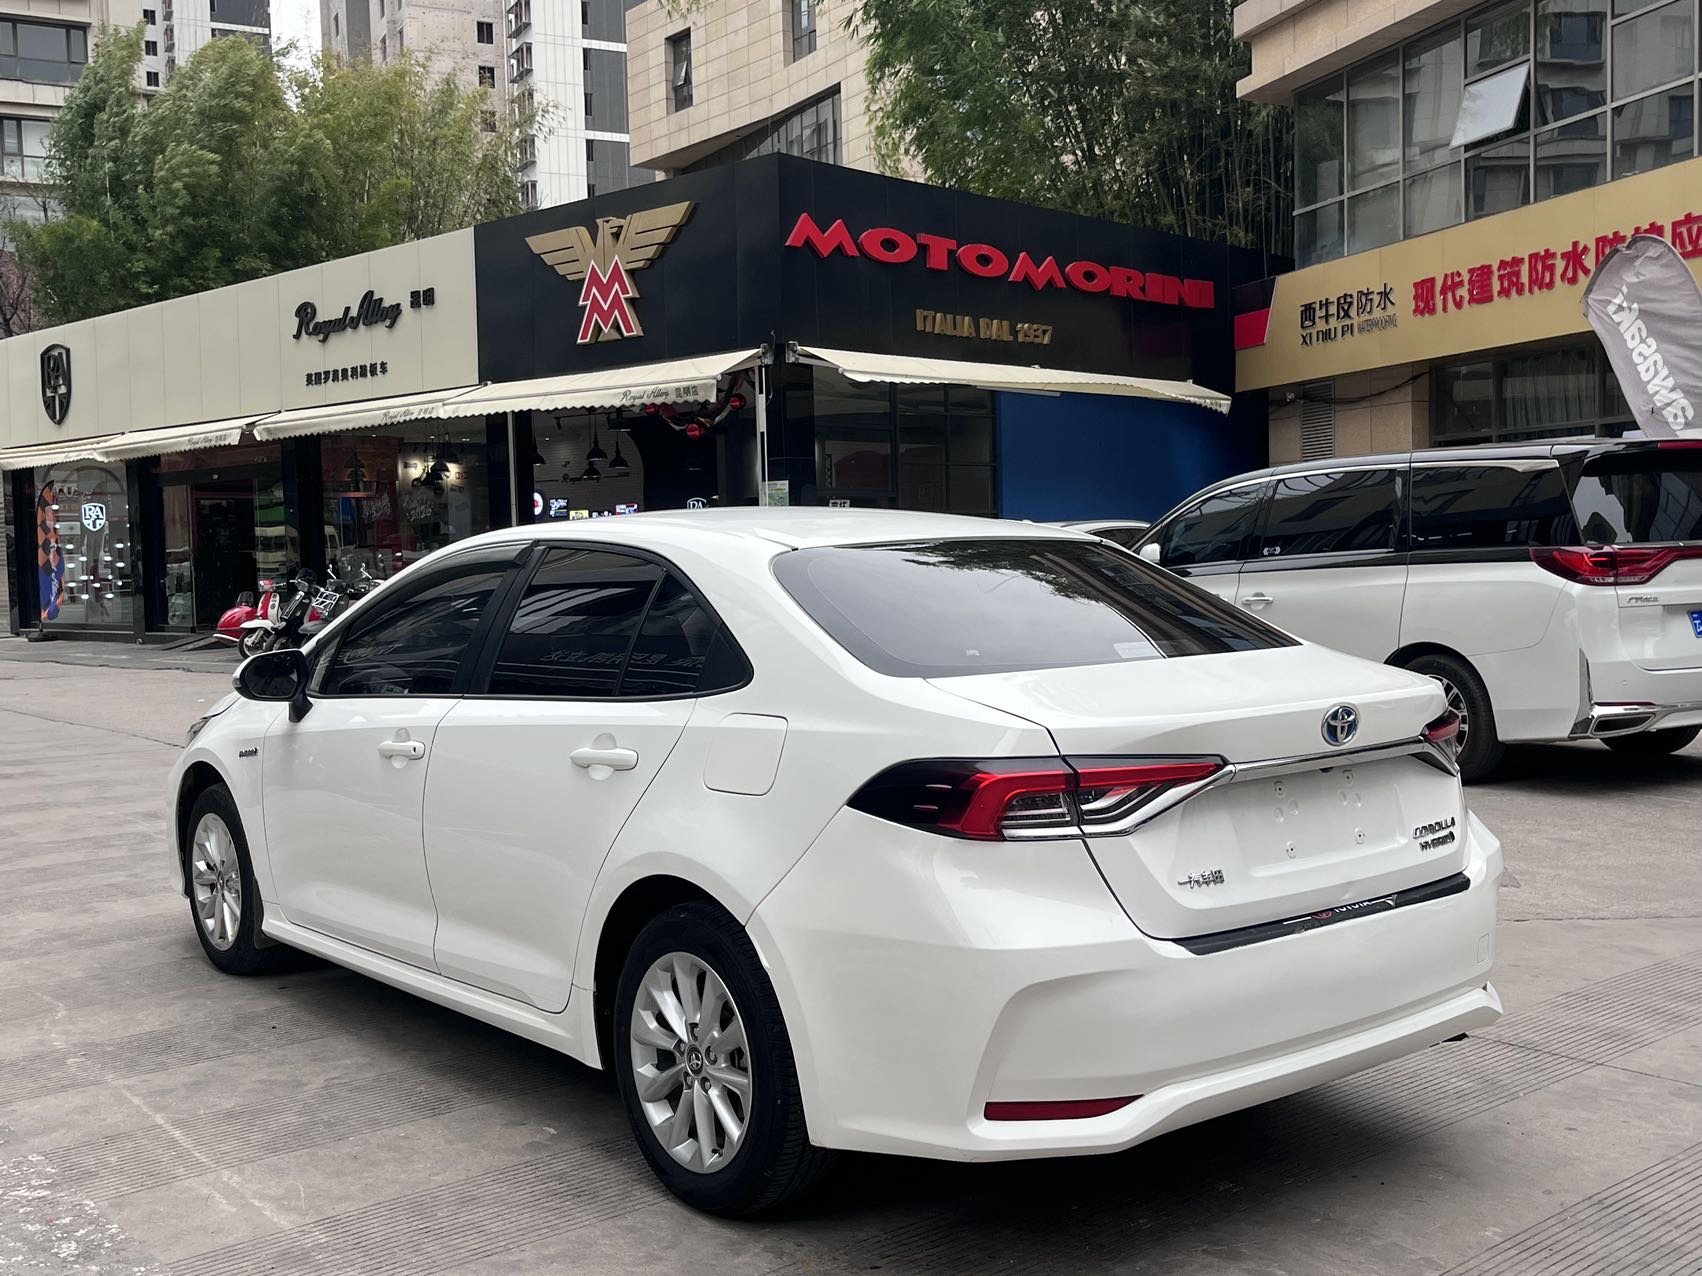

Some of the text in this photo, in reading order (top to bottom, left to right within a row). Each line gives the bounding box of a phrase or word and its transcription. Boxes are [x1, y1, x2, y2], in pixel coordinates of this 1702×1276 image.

[292, 301, 351, 343] Royal
[348, 290, 402, 329] Alloy
[915, 308, 1053, 345] ITALIA DAL 1937
[619, 389, 646, 404] Royal
[646, 386, 670, 400] Alloy
[1413, 816, 1456, 839] COROLLA
